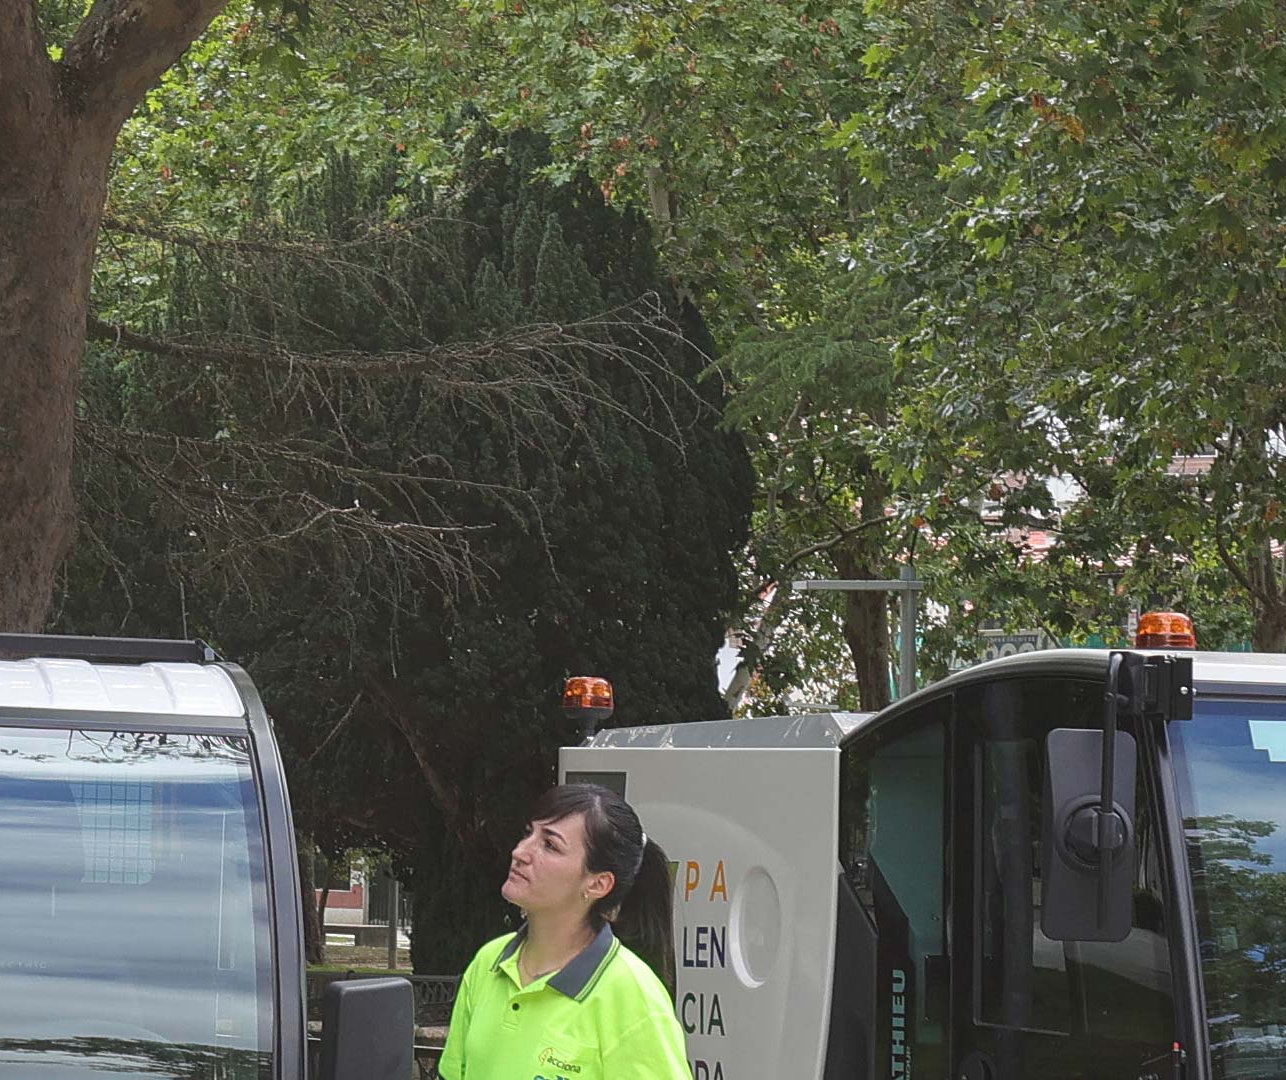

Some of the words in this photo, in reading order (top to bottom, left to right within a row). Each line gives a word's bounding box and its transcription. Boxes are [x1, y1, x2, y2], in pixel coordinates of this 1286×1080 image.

[682, 926, 727, 968] LEN
[681, 992, 726, 1036] CIA
[547, 1056, 581, 1074] acciona
